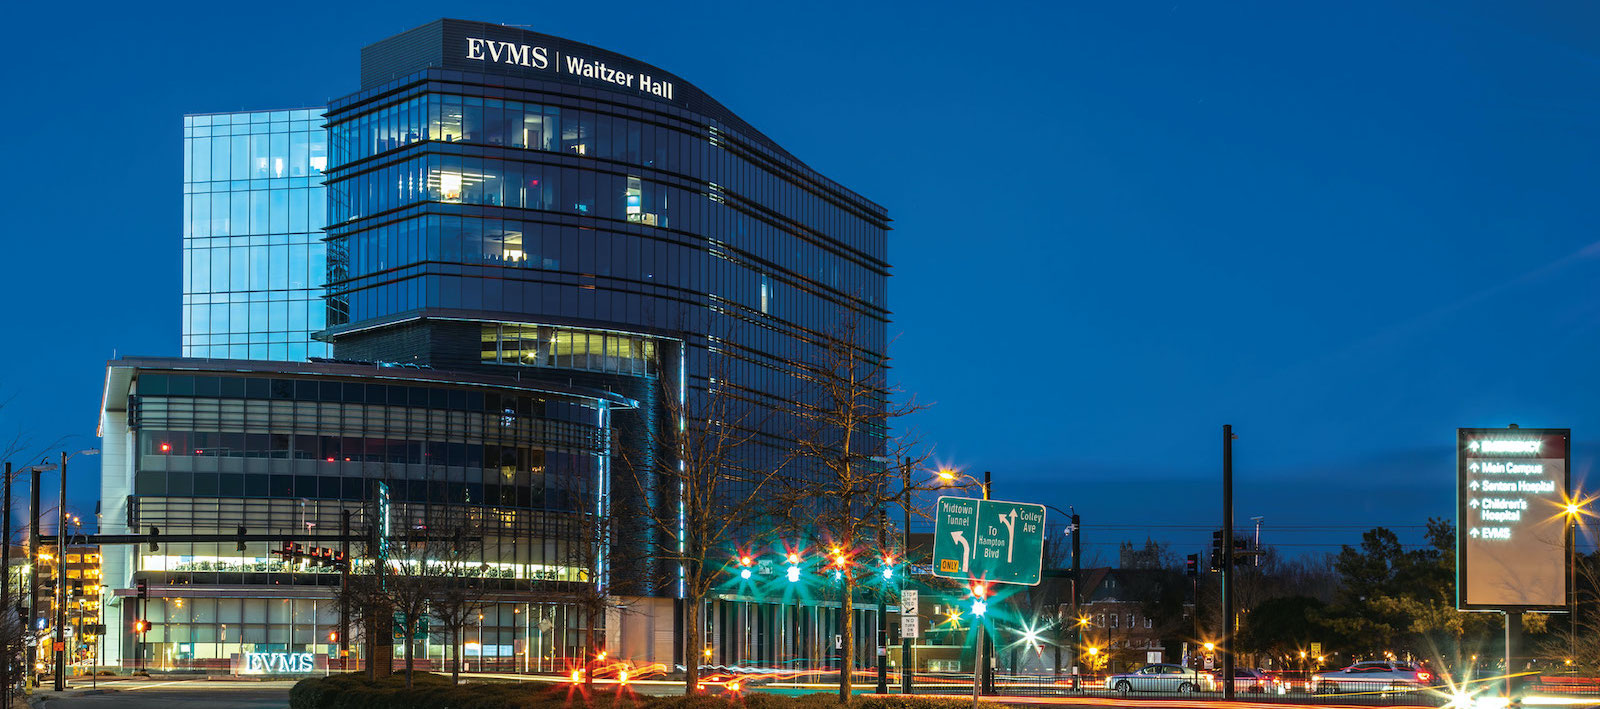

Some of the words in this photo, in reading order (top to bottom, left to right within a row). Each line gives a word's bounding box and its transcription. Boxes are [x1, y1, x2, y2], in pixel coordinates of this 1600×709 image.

[465, 37, 549, 70] EVMS
[566, 55, 634, 88] Waitzer
[639, 73, 674, 100] Hall
[1481, 461, 1505, 474] Main
[1505, 461, 1543, 476] Campus
[1481, 479, 1517, 492] Sentara
[1517, 480, 1555, 494] Hospital
[943, 502, 973, 515] Midtown
[1481, 497, 1528, 510] Children's
[947, 514, 970, 527] Tunnel
[1020, 510, 1042, 523] Colley
[1481, 509, 1520, 523] Hospital
[988, 525, 998, 536] To
[1023, 522, 1036, 533] Ave
[1481, 526, 1511, 539] EVMS
[978, 534, 1006, 547] Hampton
[984, 547, 1000, 559] Blvd
[942, 560, 958, 570] ONLY
[244, 651, 314, 673] EVMS
